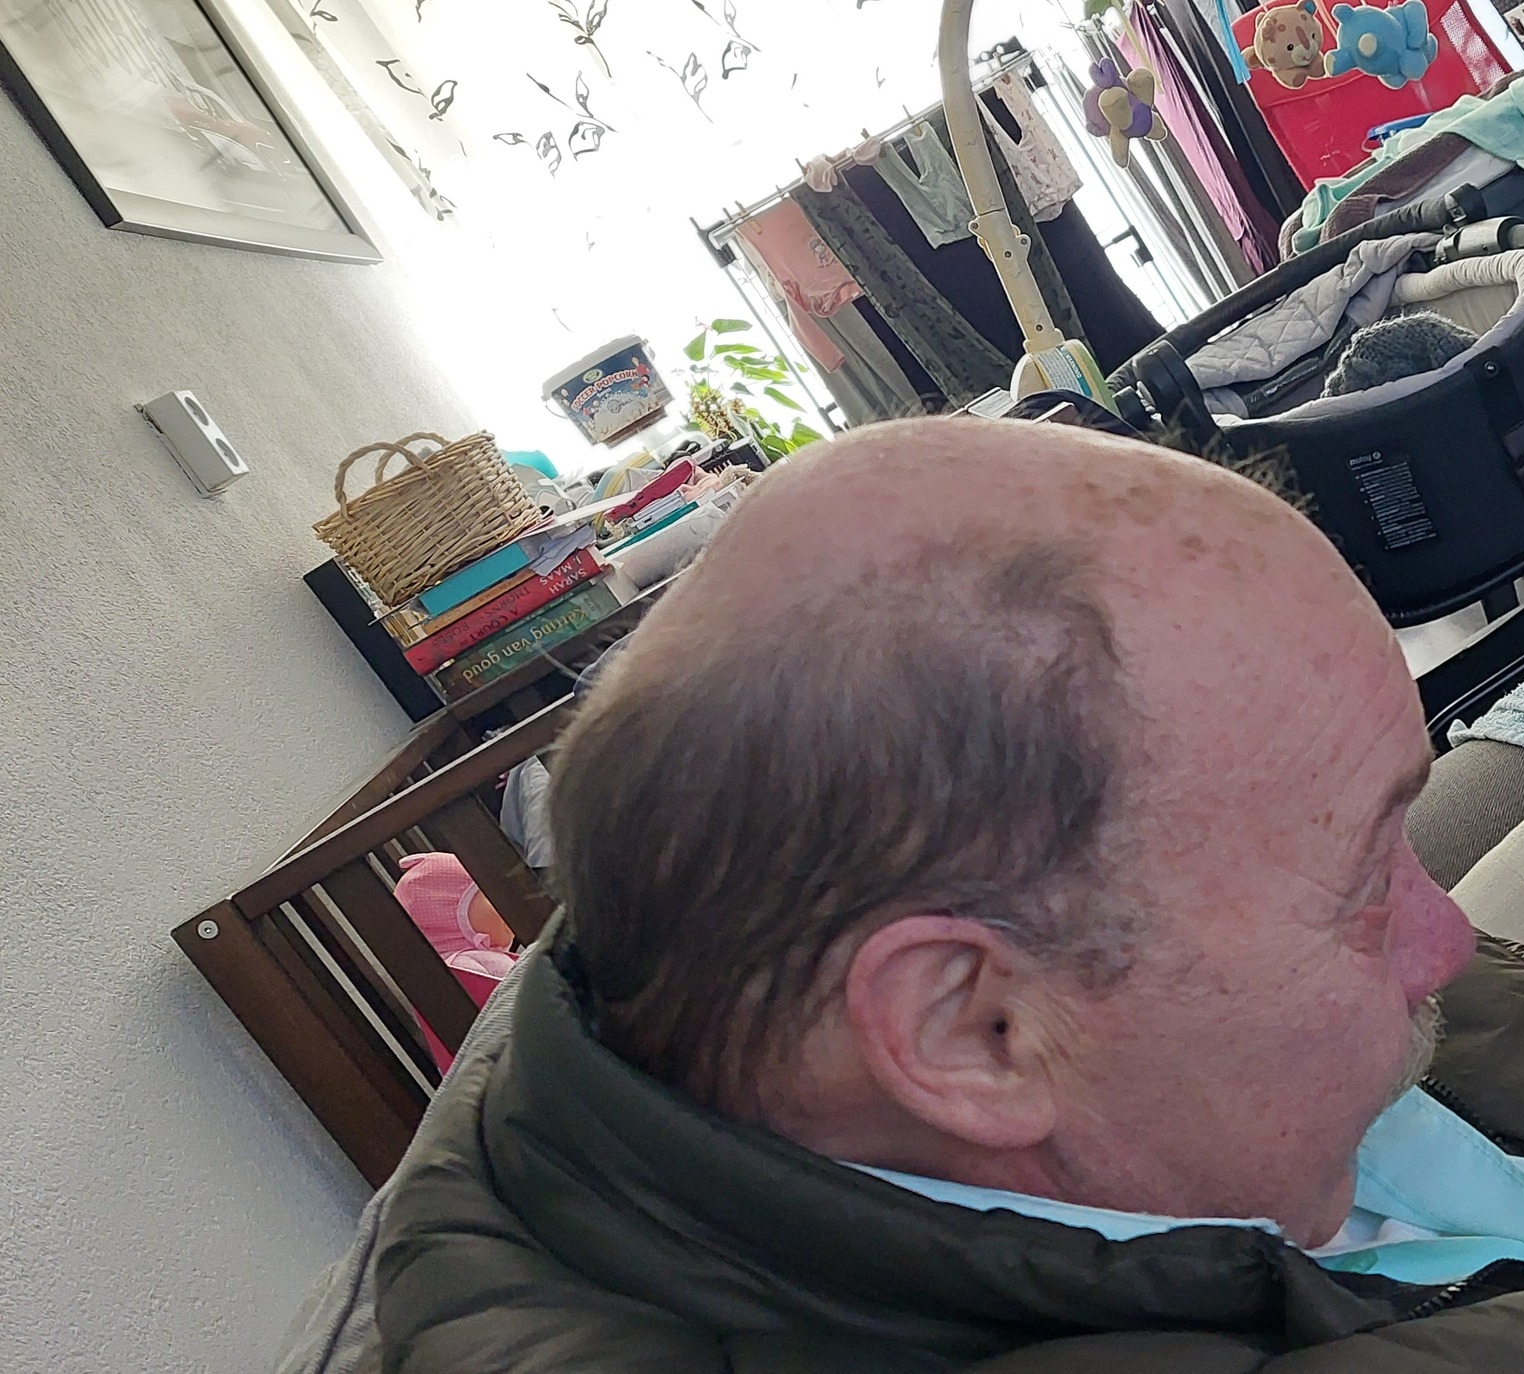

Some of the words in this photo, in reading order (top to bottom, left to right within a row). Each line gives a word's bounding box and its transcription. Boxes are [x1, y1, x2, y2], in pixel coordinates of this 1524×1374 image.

[573, 554, 583, 566] J.
[538, 561, 573, 586] MAAS
[549, 568, 587, 594] SARAH
[469, 614, 509, 642] COURT
[530, 606, 590, 642] Ketting
[503, 637, 531, 656] van
[462, 649, 501, 685] goud
